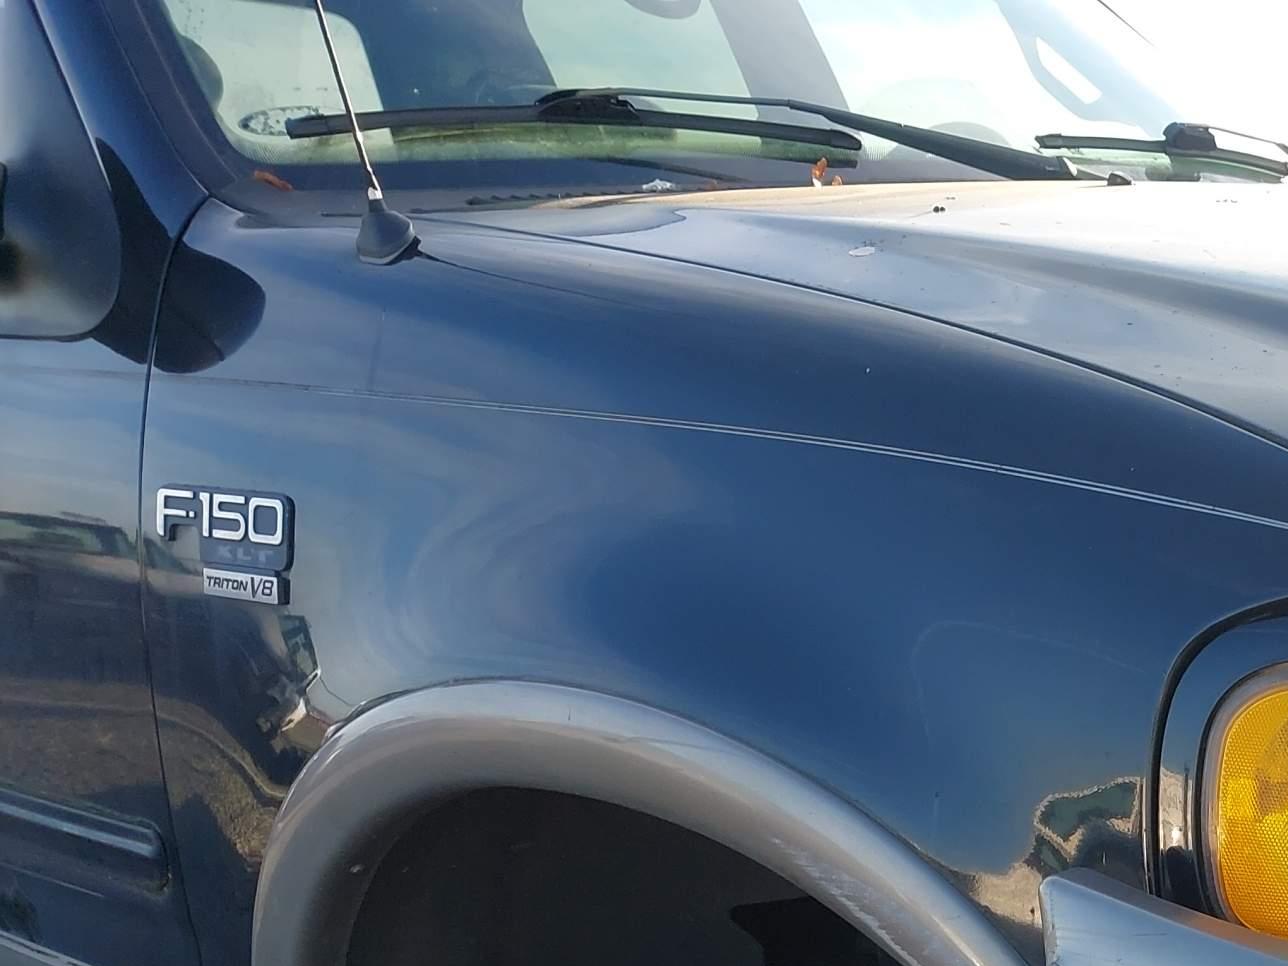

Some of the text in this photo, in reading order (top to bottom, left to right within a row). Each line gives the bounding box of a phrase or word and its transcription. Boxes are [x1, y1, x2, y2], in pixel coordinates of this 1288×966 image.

[156, 487, 284, 546] F-150
[216, 545, 273, 562] XLT
[206, 575, 275, 599] TRITON V8
